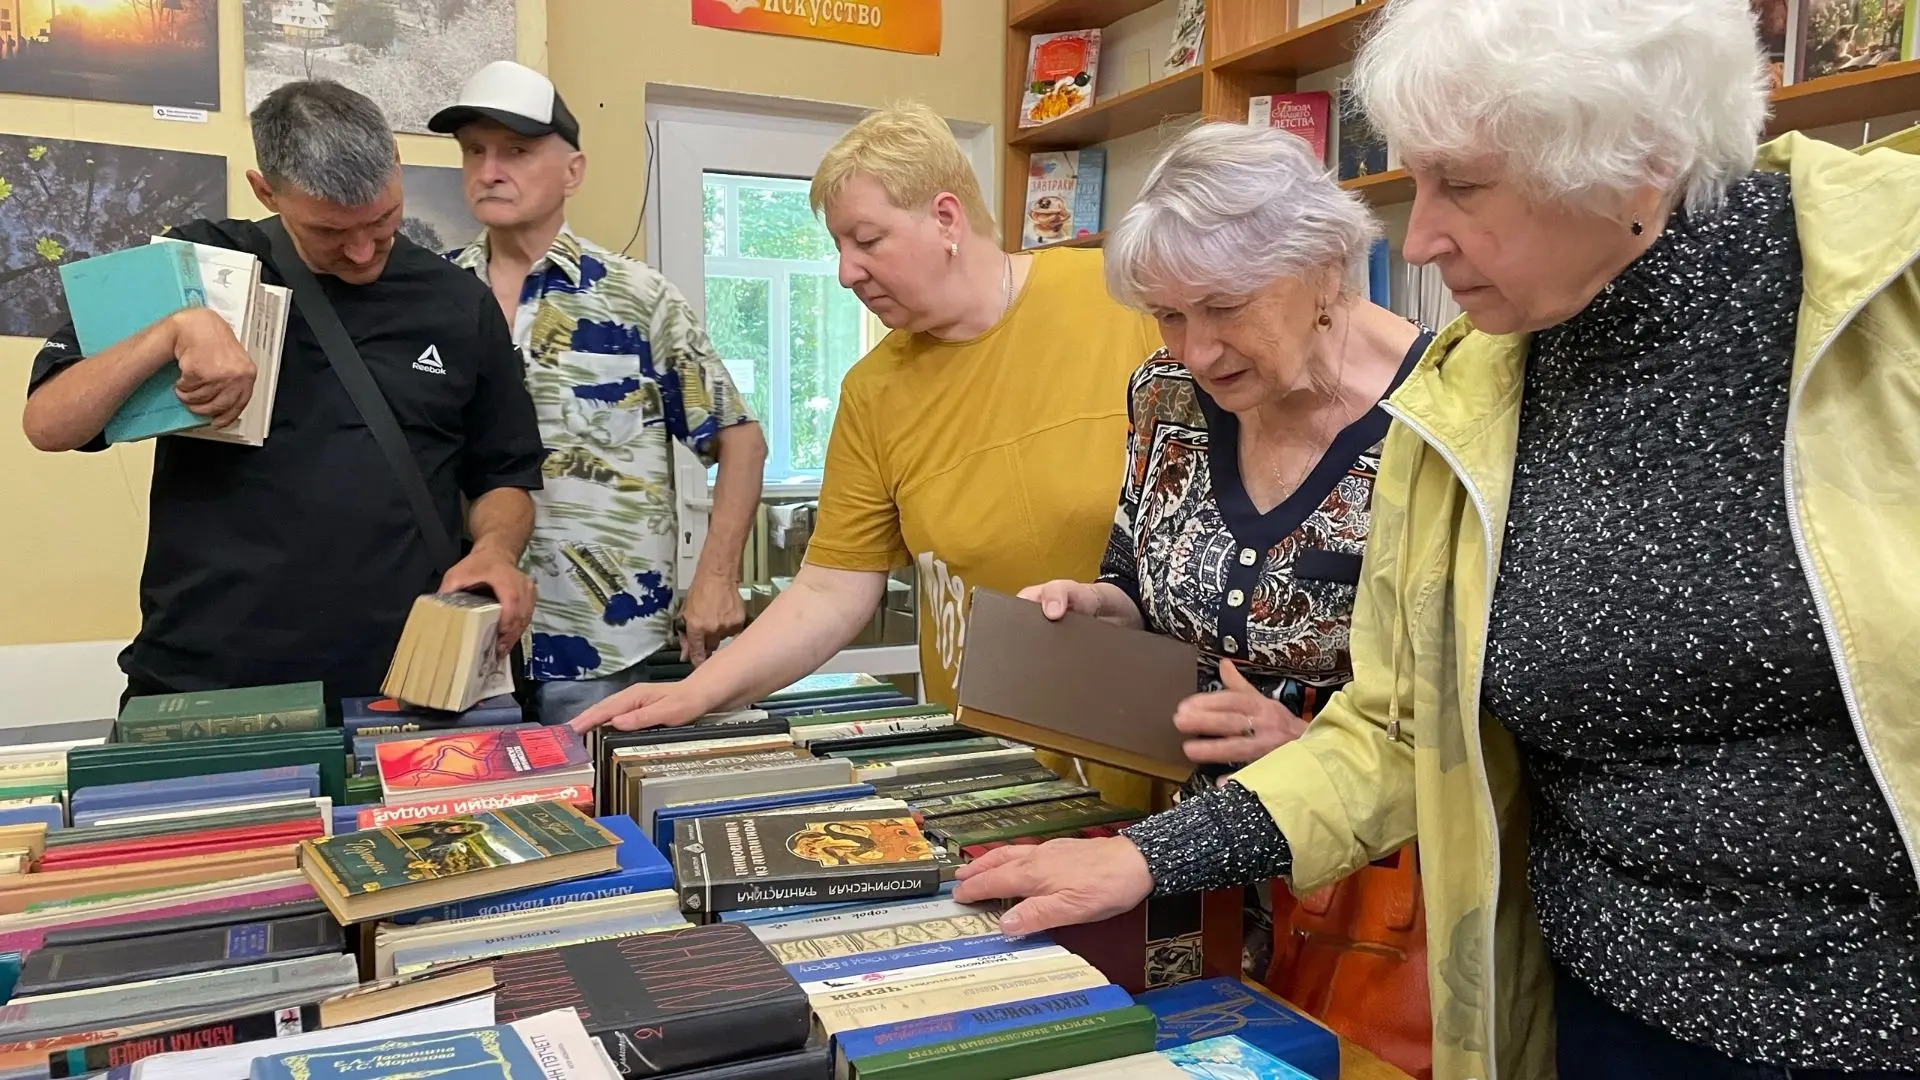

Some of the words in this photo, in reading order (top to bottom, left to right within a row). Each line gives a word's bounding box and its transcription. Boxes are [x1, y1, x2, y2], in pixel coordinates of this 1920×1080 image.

[1274, 117, 1315, 129] ДЕТСТВА
[1031, 179, 1075, 193] ЗАВТРАКИ
[412, 361, 447, 375] Reebok
[454, 792, 538, 815] АРКАДИЙ
[377, 803, 449, 826] ГАЙДАР
[549, 884, 634, 907] АНАТОЛИЙ
[736, 885, 818, 903] ФАНТАСТИКА
[828, 878, 922, 896] ИСТОРИЧЕСКАЯ
[478, 898, 545, 918] ИВАНОВ
[851, 908, 889, 921] сорок
[798, 957, 841, 975] Европу
[829, 983, 903, 1003] ЧЕРВИ
[1041, 993, 1090, 1013] АГАТА
[970, 1002, 1039, 1025] КРИСТИ
[170, 1024, 234, 1053] АЗБУКА
[633, 1025, 665, 1041] 2
[530, 1033, 560, 1069] ПЭТЧЕТТ
[906, 1043, 957, 1061] ПОРТРЕТ
[375, 1052, 456, 1069] Морозова
